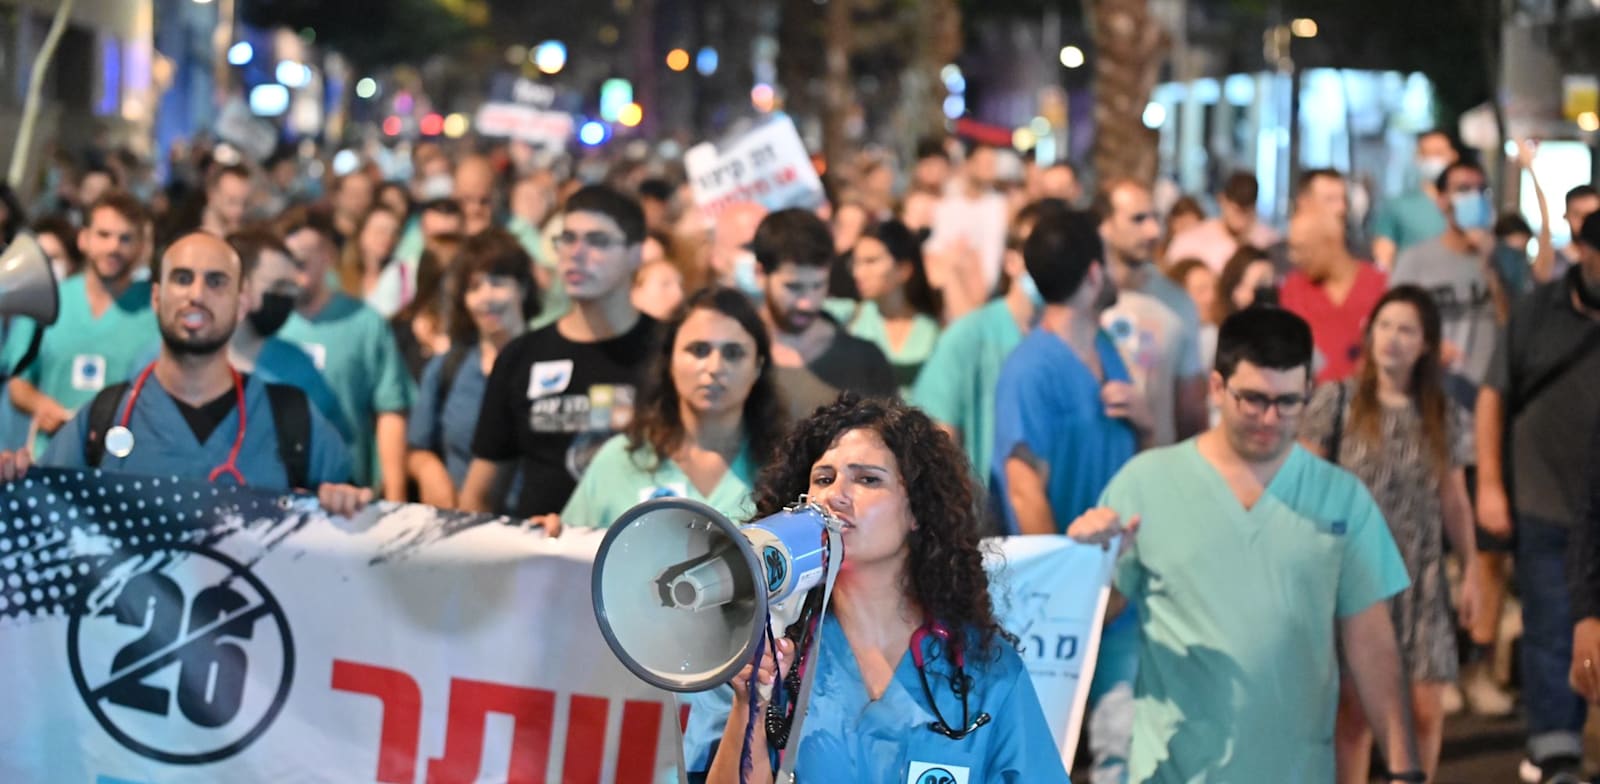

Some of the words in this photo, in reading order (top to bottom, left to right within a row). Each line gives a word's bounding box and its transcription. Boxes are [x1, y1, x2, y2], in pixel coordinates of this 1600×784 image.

[108, 571, 253, 728] 26
[1030, 633, 1079, 659] מר
[331, 658, 691, 784] וותר
